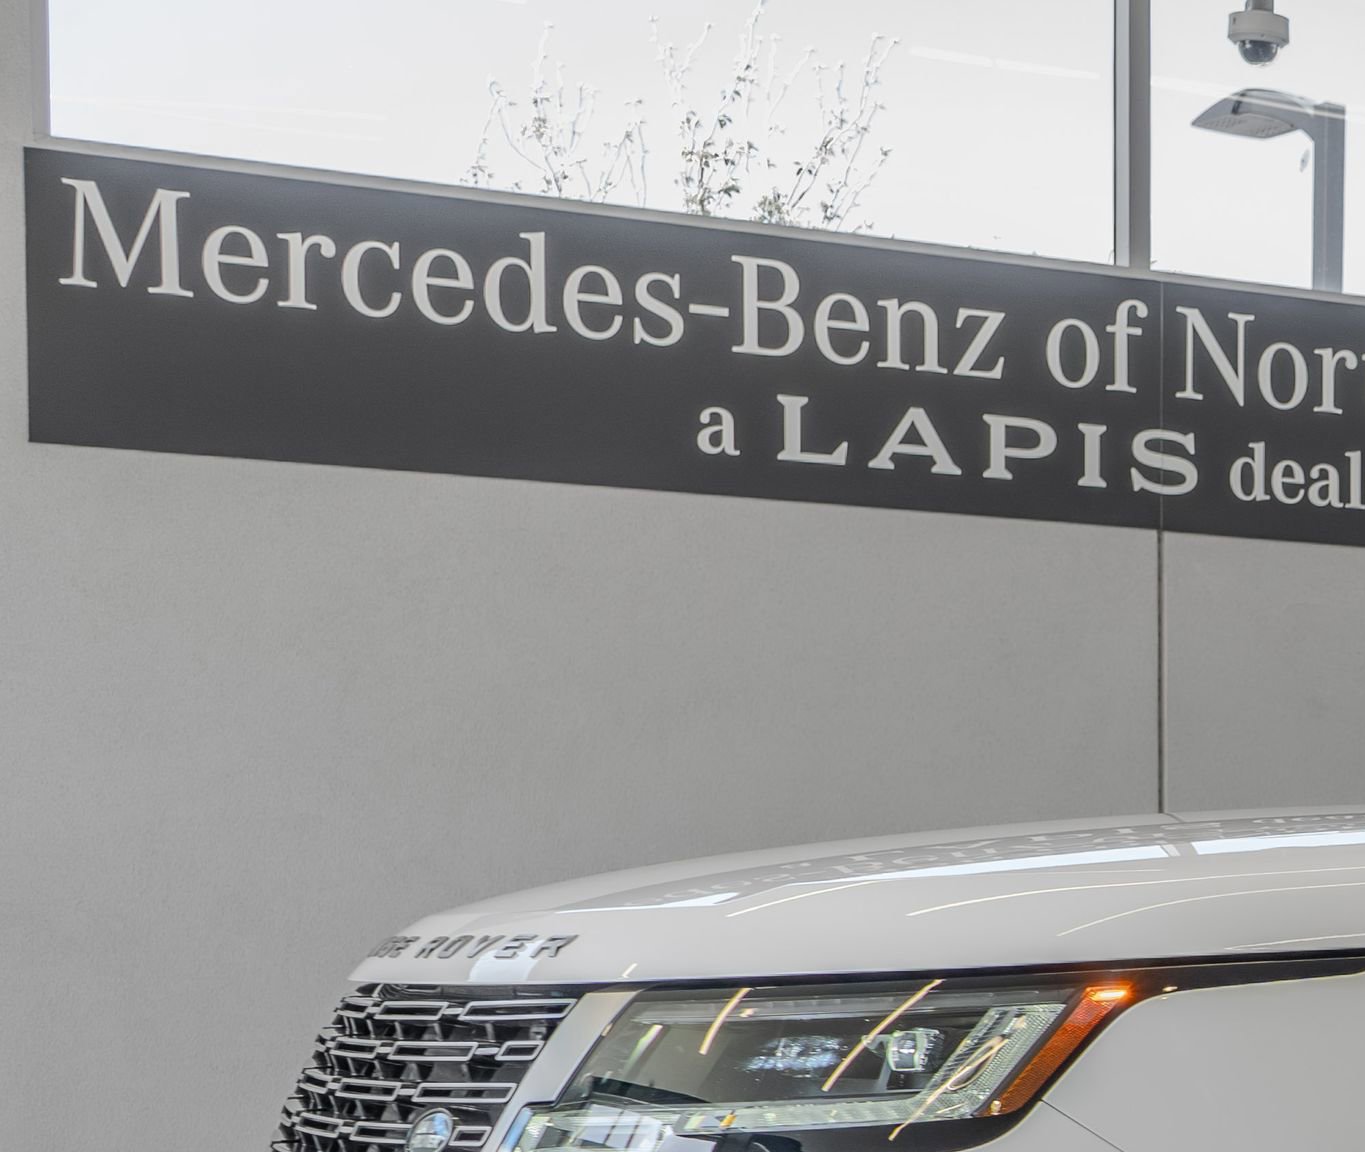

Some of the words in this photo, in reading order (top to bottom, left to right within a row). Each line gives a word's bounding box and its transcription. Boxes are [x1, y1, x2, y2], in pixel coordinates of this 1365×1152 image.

[59, 177, 1005, 380] Mercedes-Benz
[1045, 299, 1149, 393] of
[697, 406, 740, 455] a
[777, 394, 1200, 496] LAPIS
[414, 934, 579, 959] ROVER
